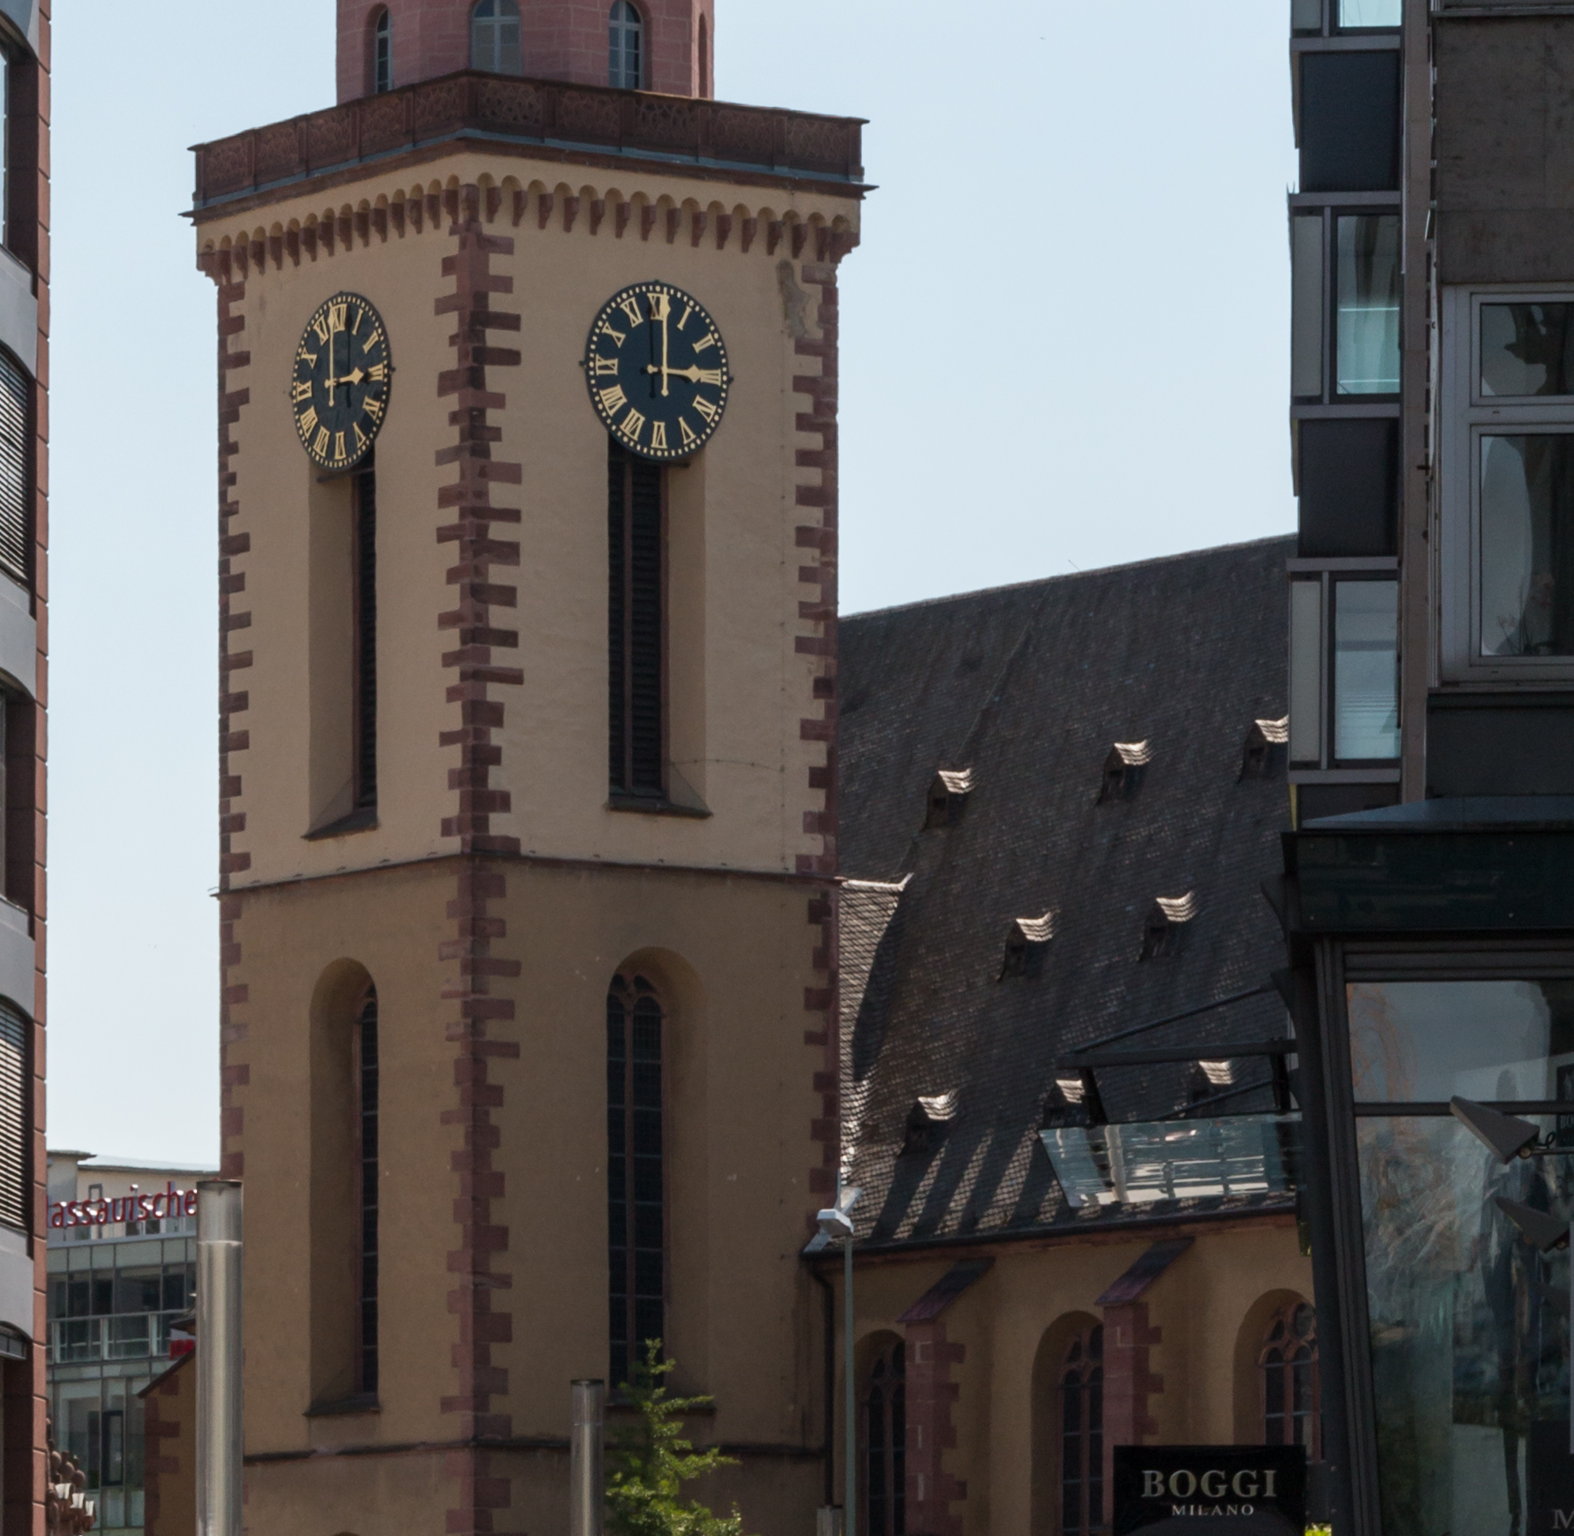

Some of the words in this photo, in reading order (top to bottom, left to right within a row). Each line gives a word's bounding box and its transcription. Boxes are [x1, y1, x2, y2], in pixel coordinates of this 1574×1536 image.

[47, 1181, 197, 1228] assauische
[1141, 1469, 1278, 1498] BOGGI
[1171, 1504, 1255, 1516] MILANO
